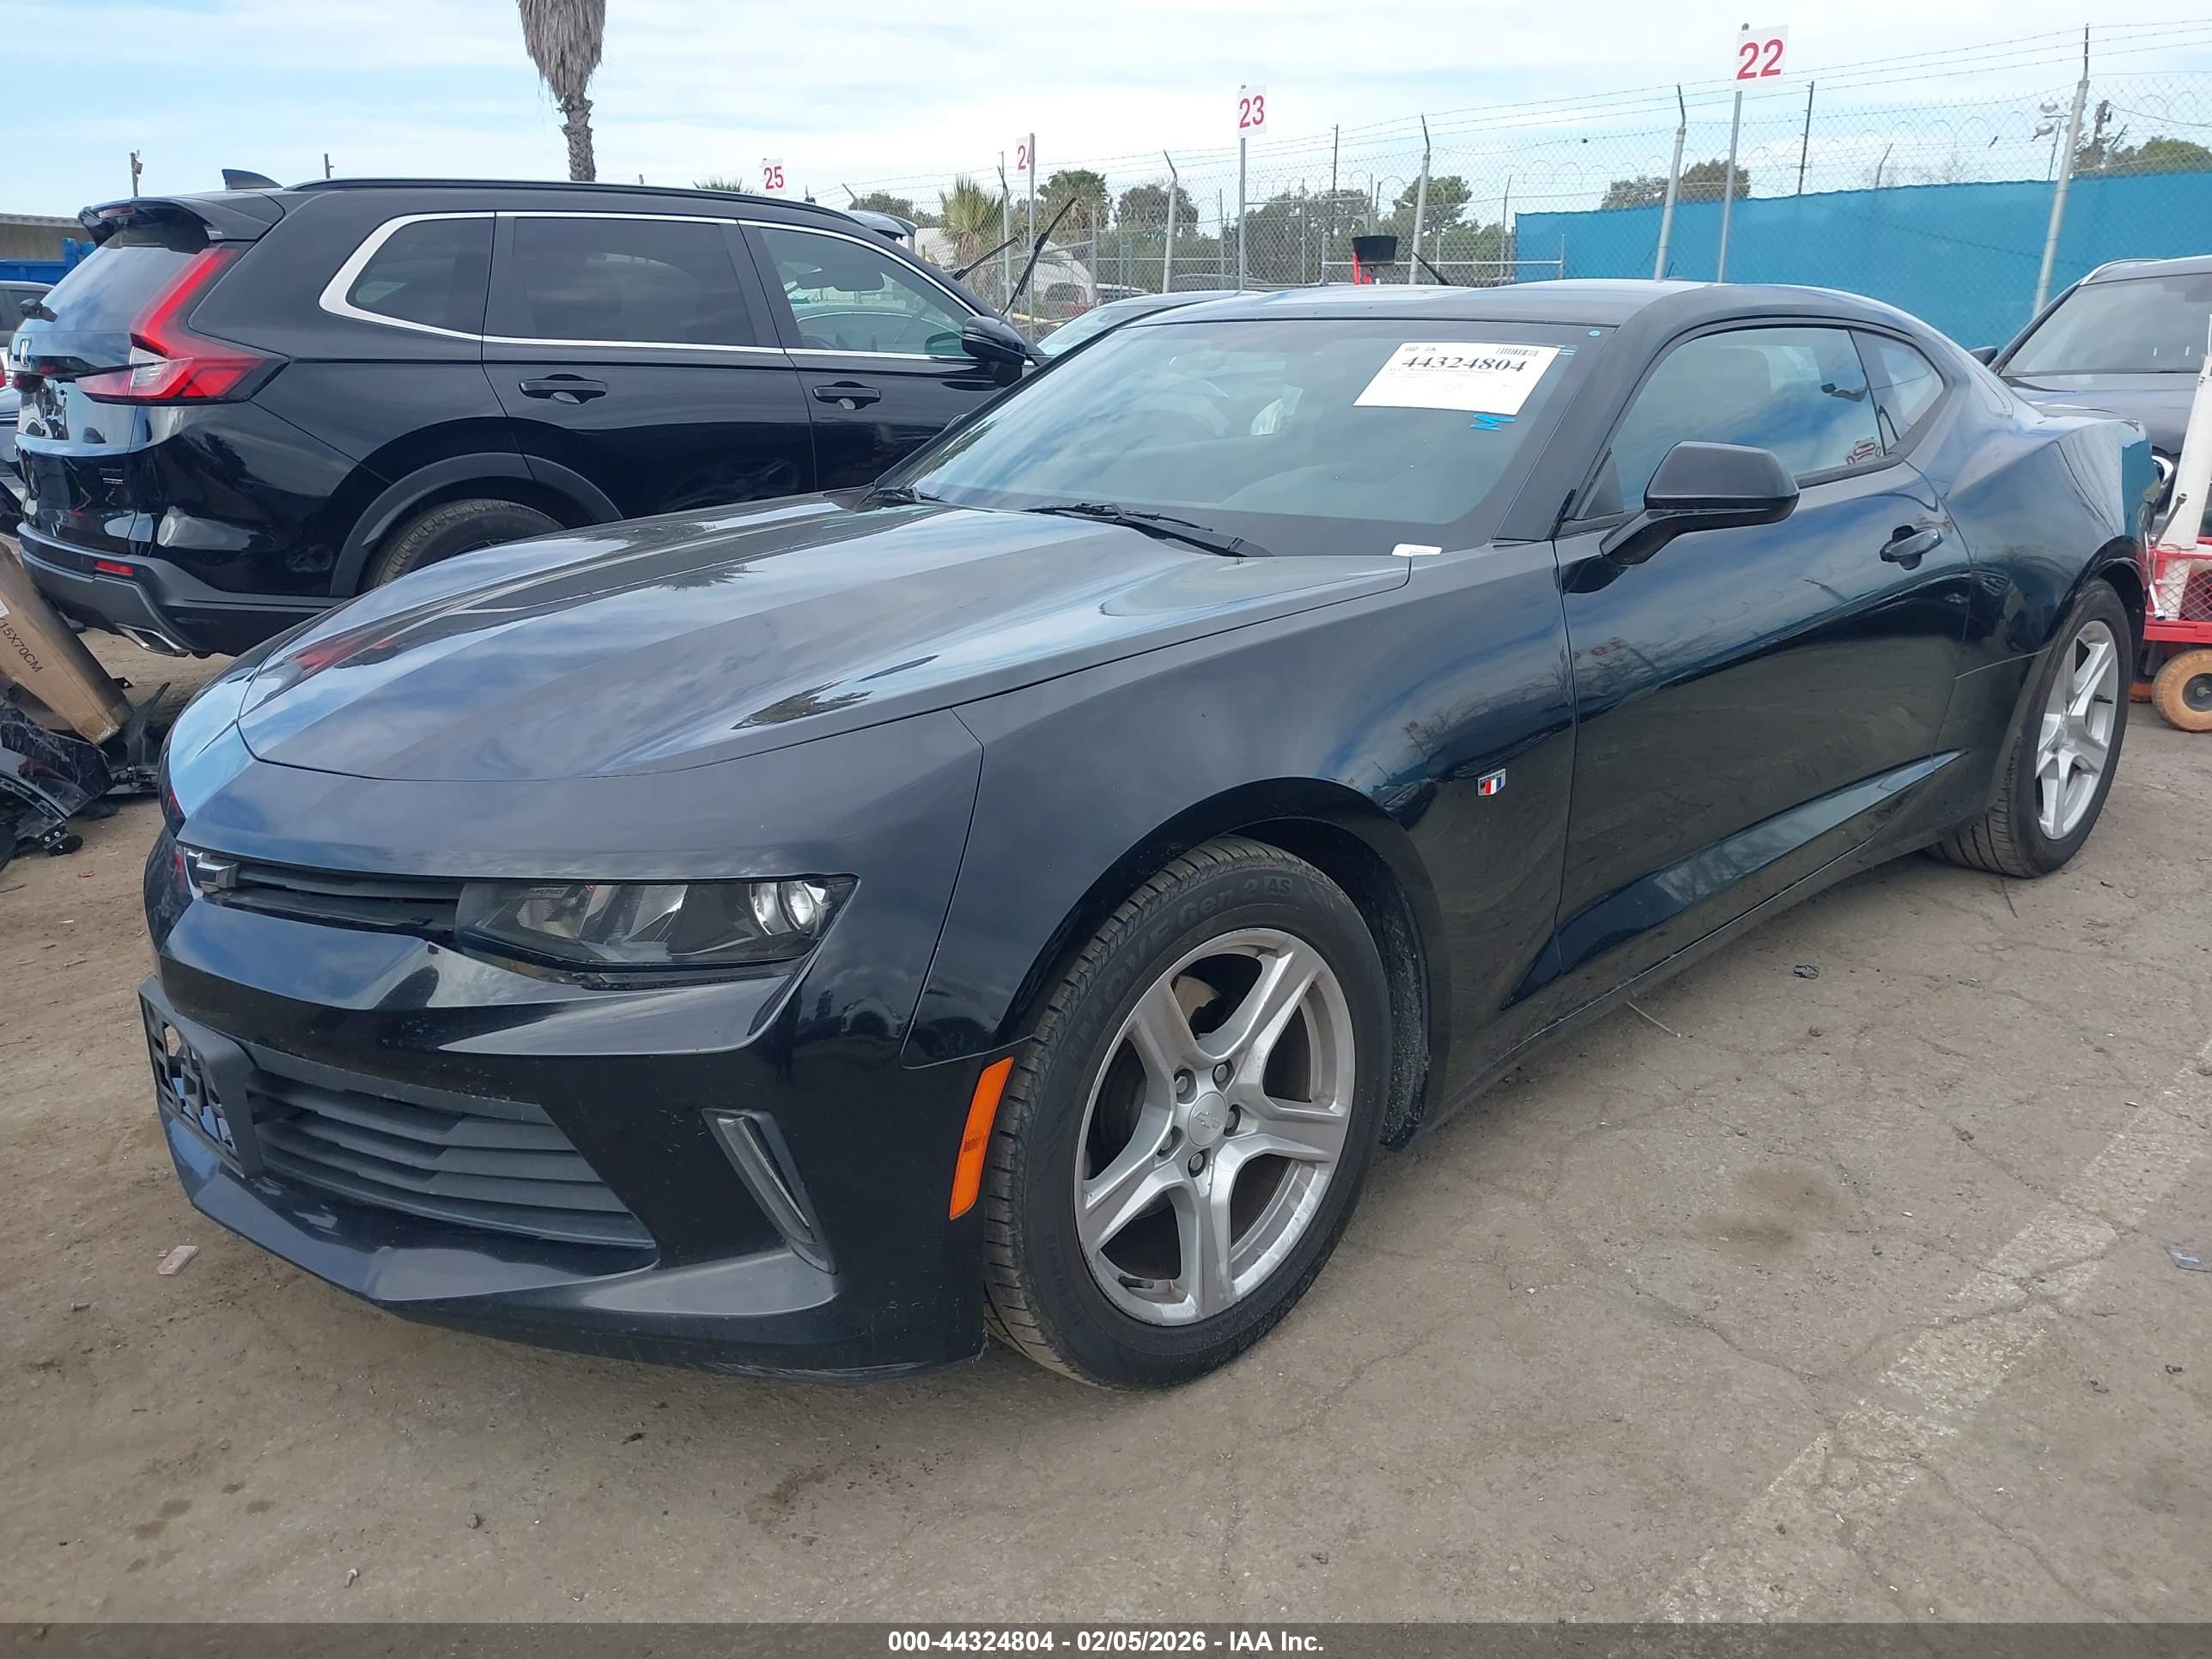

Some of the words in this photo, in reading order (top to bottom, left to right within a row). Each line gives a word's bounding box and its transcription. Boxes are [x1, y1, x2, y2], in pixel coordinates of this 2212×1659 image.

[1736, 40, 1784, 80] 22
[1239, 95, 1264, 129] 23
[764, 166, 784, 190] 25
[1402, 356, 1528, 372] 44324804
[0, 617, 44, 672] 15X70CM
[1179, 889, 1235, 927] Gen
[1243, 878, 1258, 898] 2
[1264, 877, 1291, 895] AS
